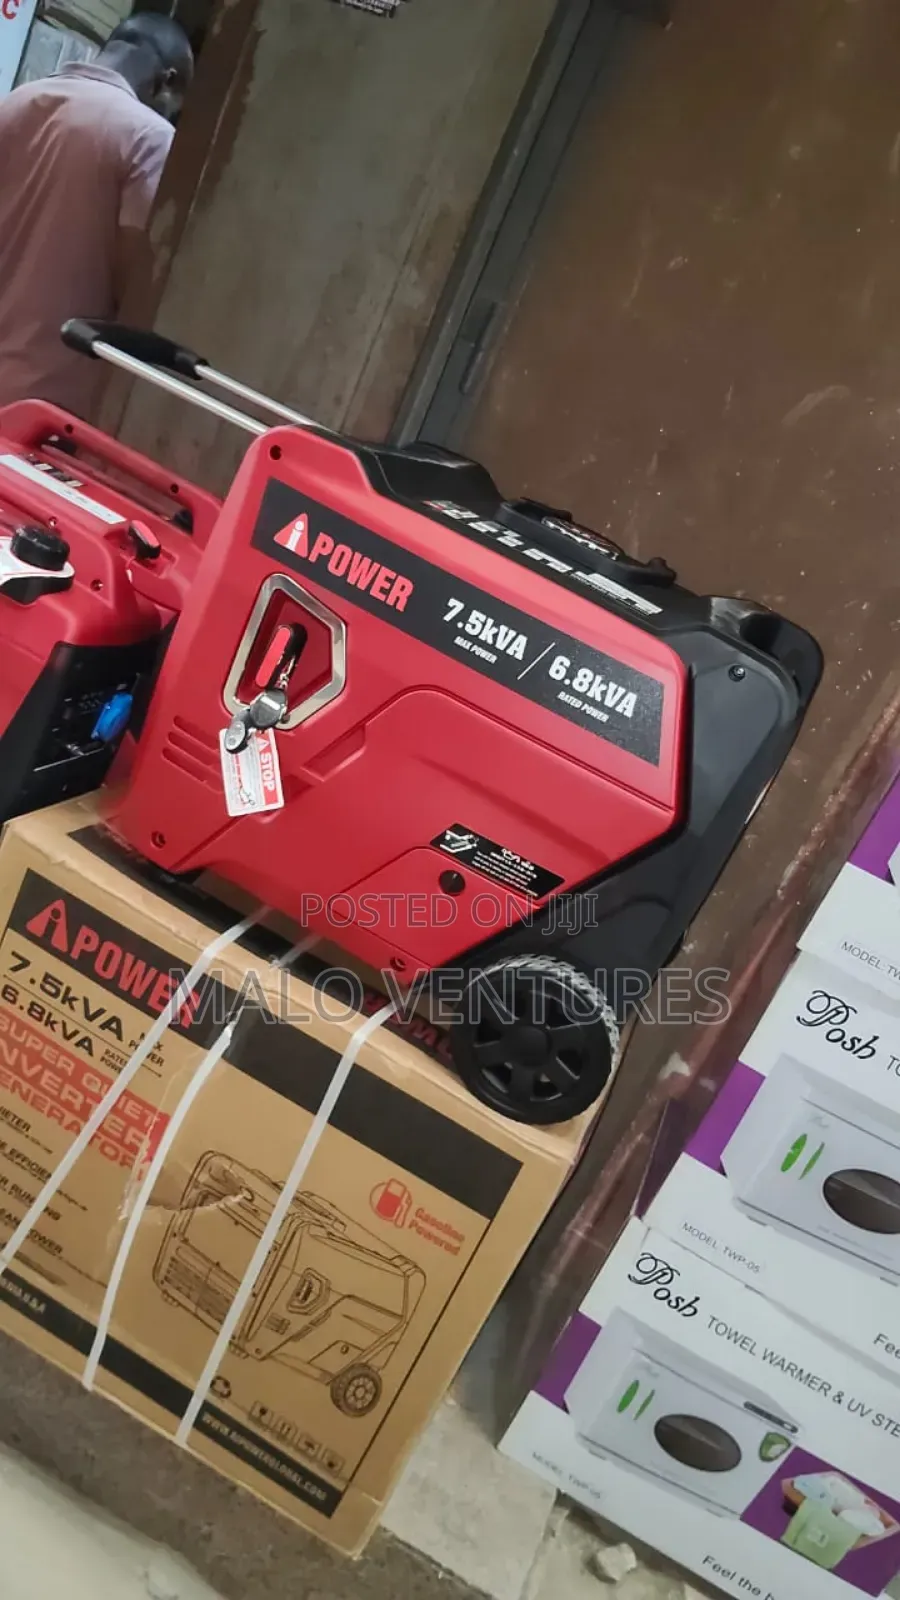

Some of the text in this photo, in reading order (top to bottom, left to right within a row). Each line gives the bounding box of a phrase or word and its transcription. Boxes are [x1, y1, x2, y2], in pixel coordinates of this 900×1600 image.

[442, 597, 528, 661] 7.5kVA
[548, 655, 638, 718] 6.8kVA
[454, 636, 498, 664] MAX POWER
[557, 691, 609, 723] RATED POWER
[259, 752, 276, 792] STOP
[1, 983, 94, 1057] 6.8kVA
[9, 951, 124, 1042] 7.5kVA
[796, 990, 879, 1059] Posh
[627, 1252, 701, 1318] Posh
[706, 1315, 757, 1356] TOWEL
[762, 1347, 832, 1397] WARMER
[832, 1390, 845, 1405] &
[847, 1398, 874, 1418] UV
[702, 1554, 738, 1581] Feel
[737, 1577, 762, 1597] the
